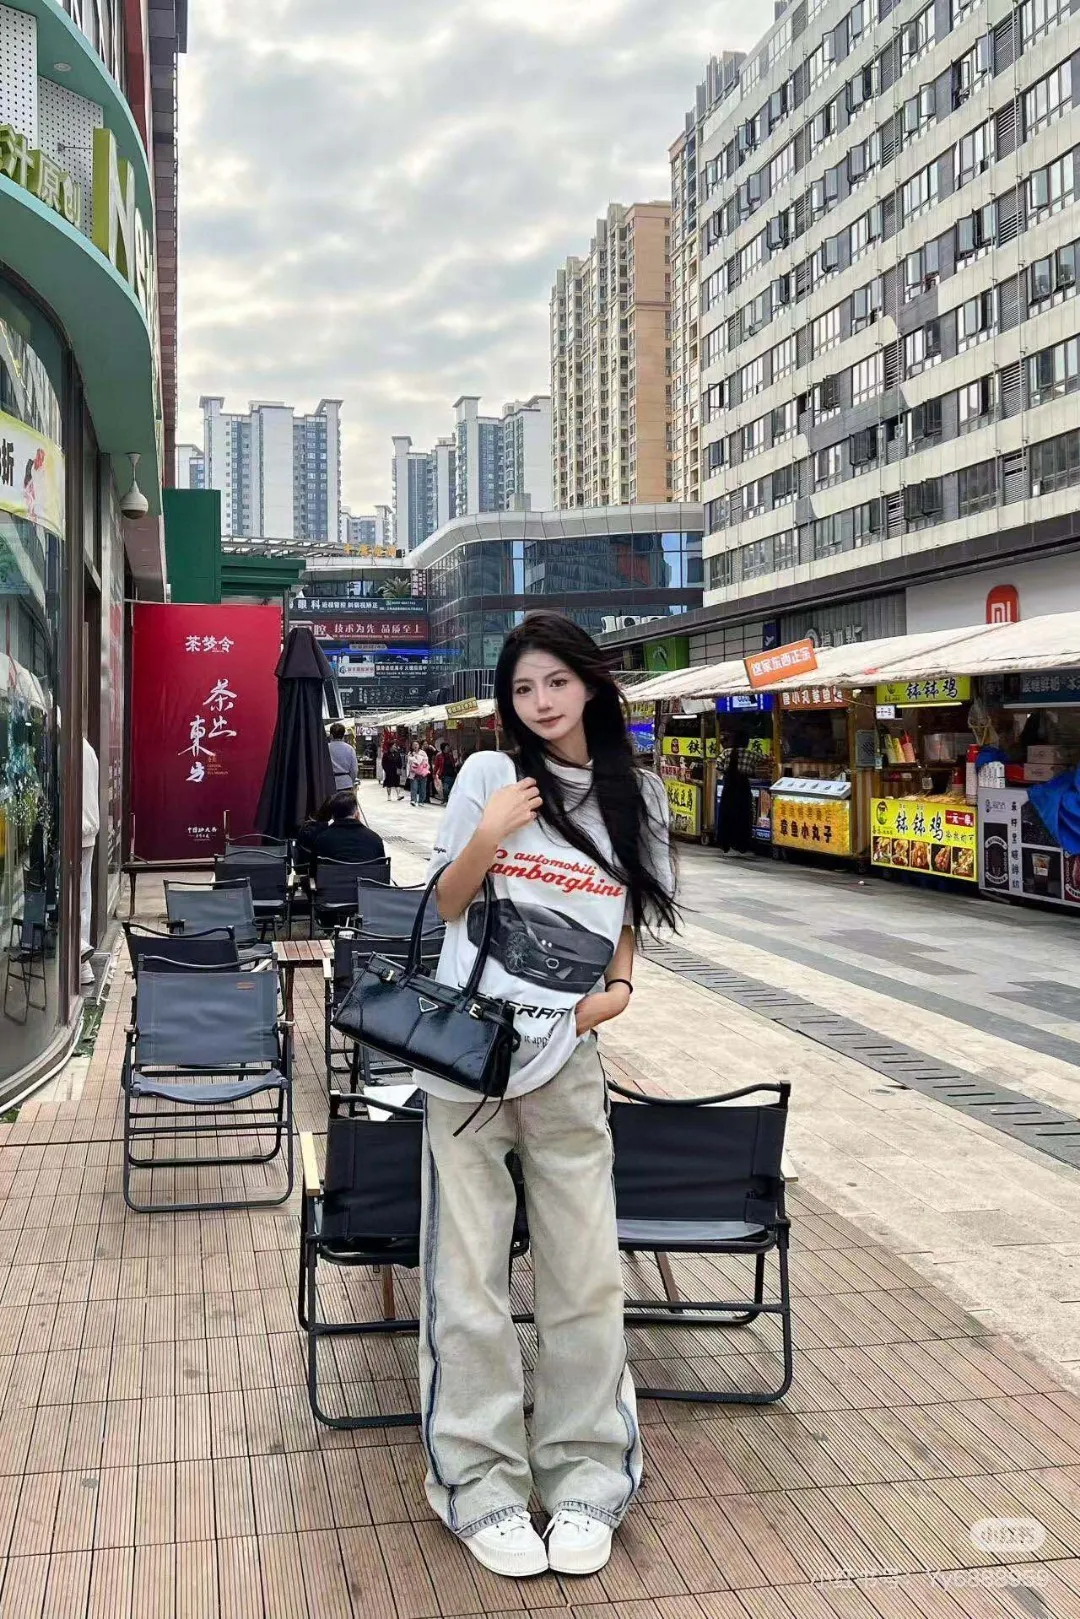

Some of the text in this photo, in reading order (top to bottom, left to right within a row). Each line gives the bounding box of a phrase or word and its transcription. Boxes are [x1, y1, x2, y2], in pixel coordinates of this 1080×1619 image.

[335, 624, 375, 634] 技术为先
[381, 624, 422, 634] 品质至上
[780, 818, 833, 844] 章鱼小丸子
[895, 810, 944, 842] 钵钵鸡
[514, 852, 596, 876] automobili
[488, 860, 624, 897] amborghini
